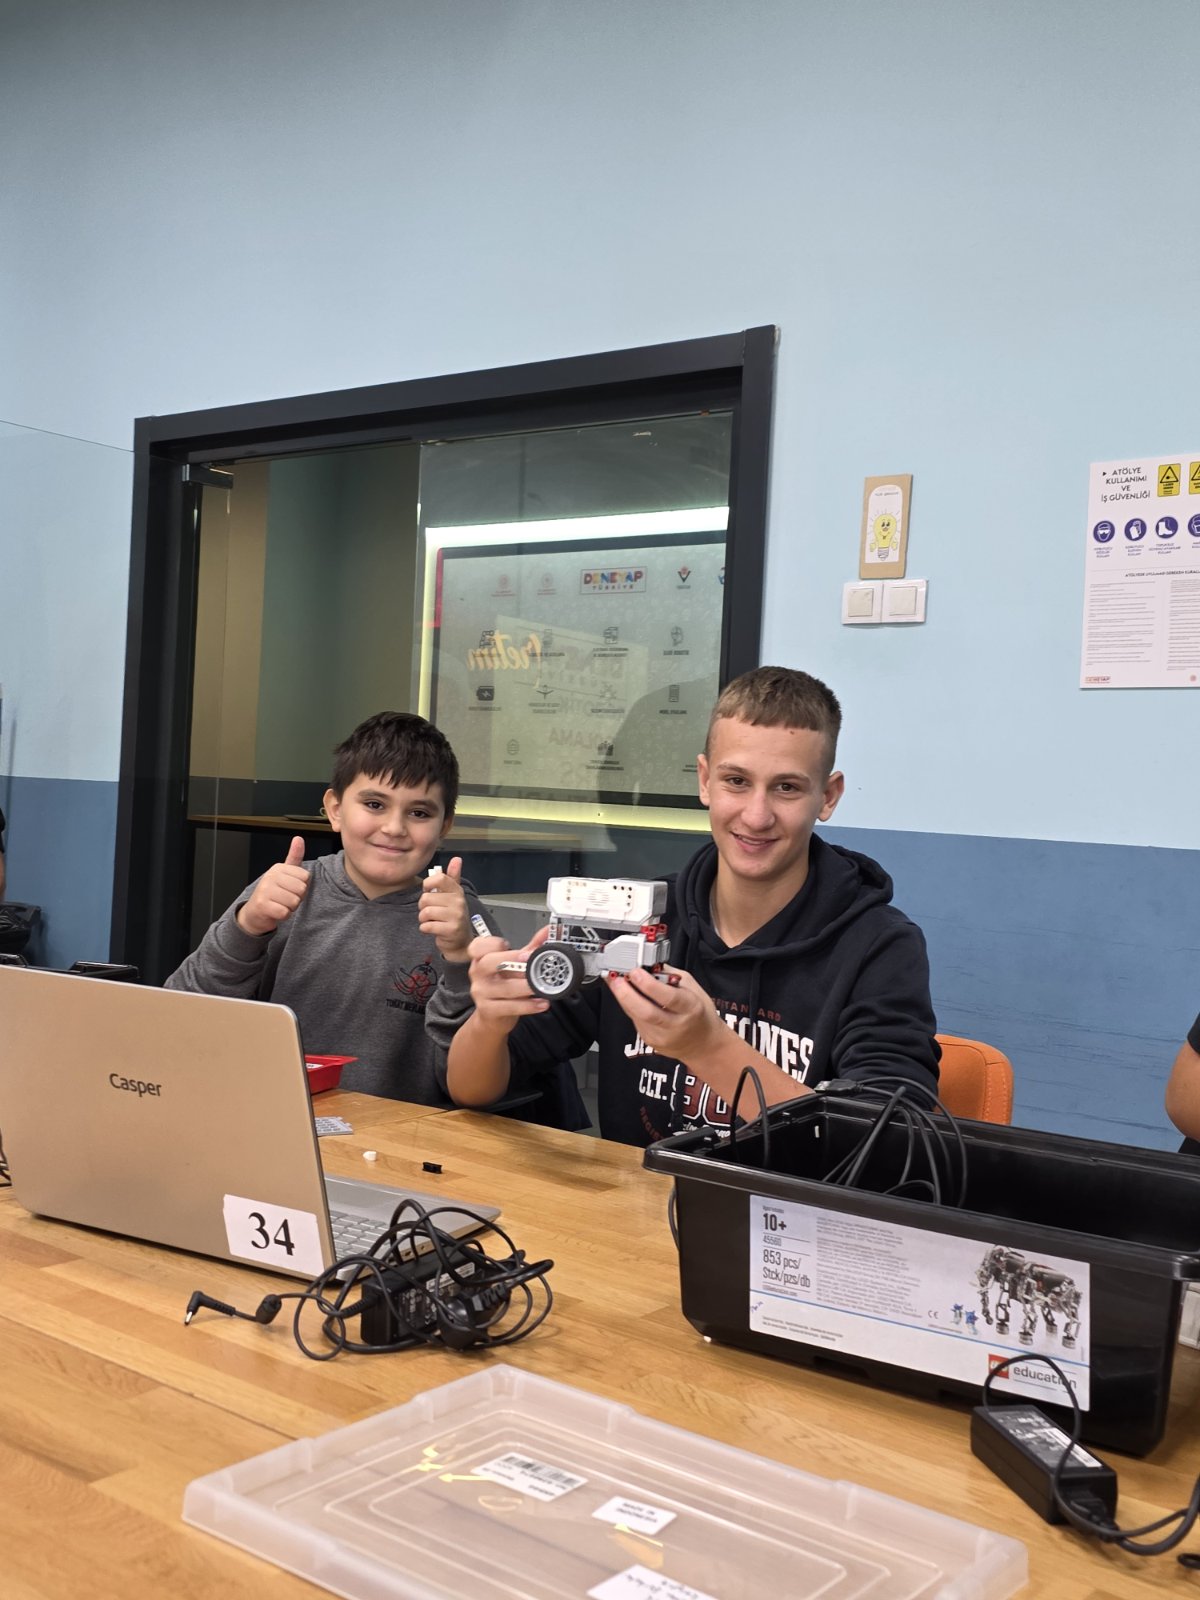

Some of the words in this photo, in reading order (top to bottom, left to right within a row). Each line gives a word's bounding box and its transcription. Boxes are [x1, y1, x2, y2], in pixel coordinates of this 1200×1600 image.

[1112, 467, 1141, 476] ATÖLYE
[584, 570, 643, 584] DENEYAP
[109, 1073, 162, 1098] Casper
[763, 1213, 787, 1231] 10+
[248, 1212, 295, 1256] 34
[763, 1249, 781, 1266] 853
[783, 1257, 801, 1270] pcs/
[1013, 1366, 1077, 1389] educatin
